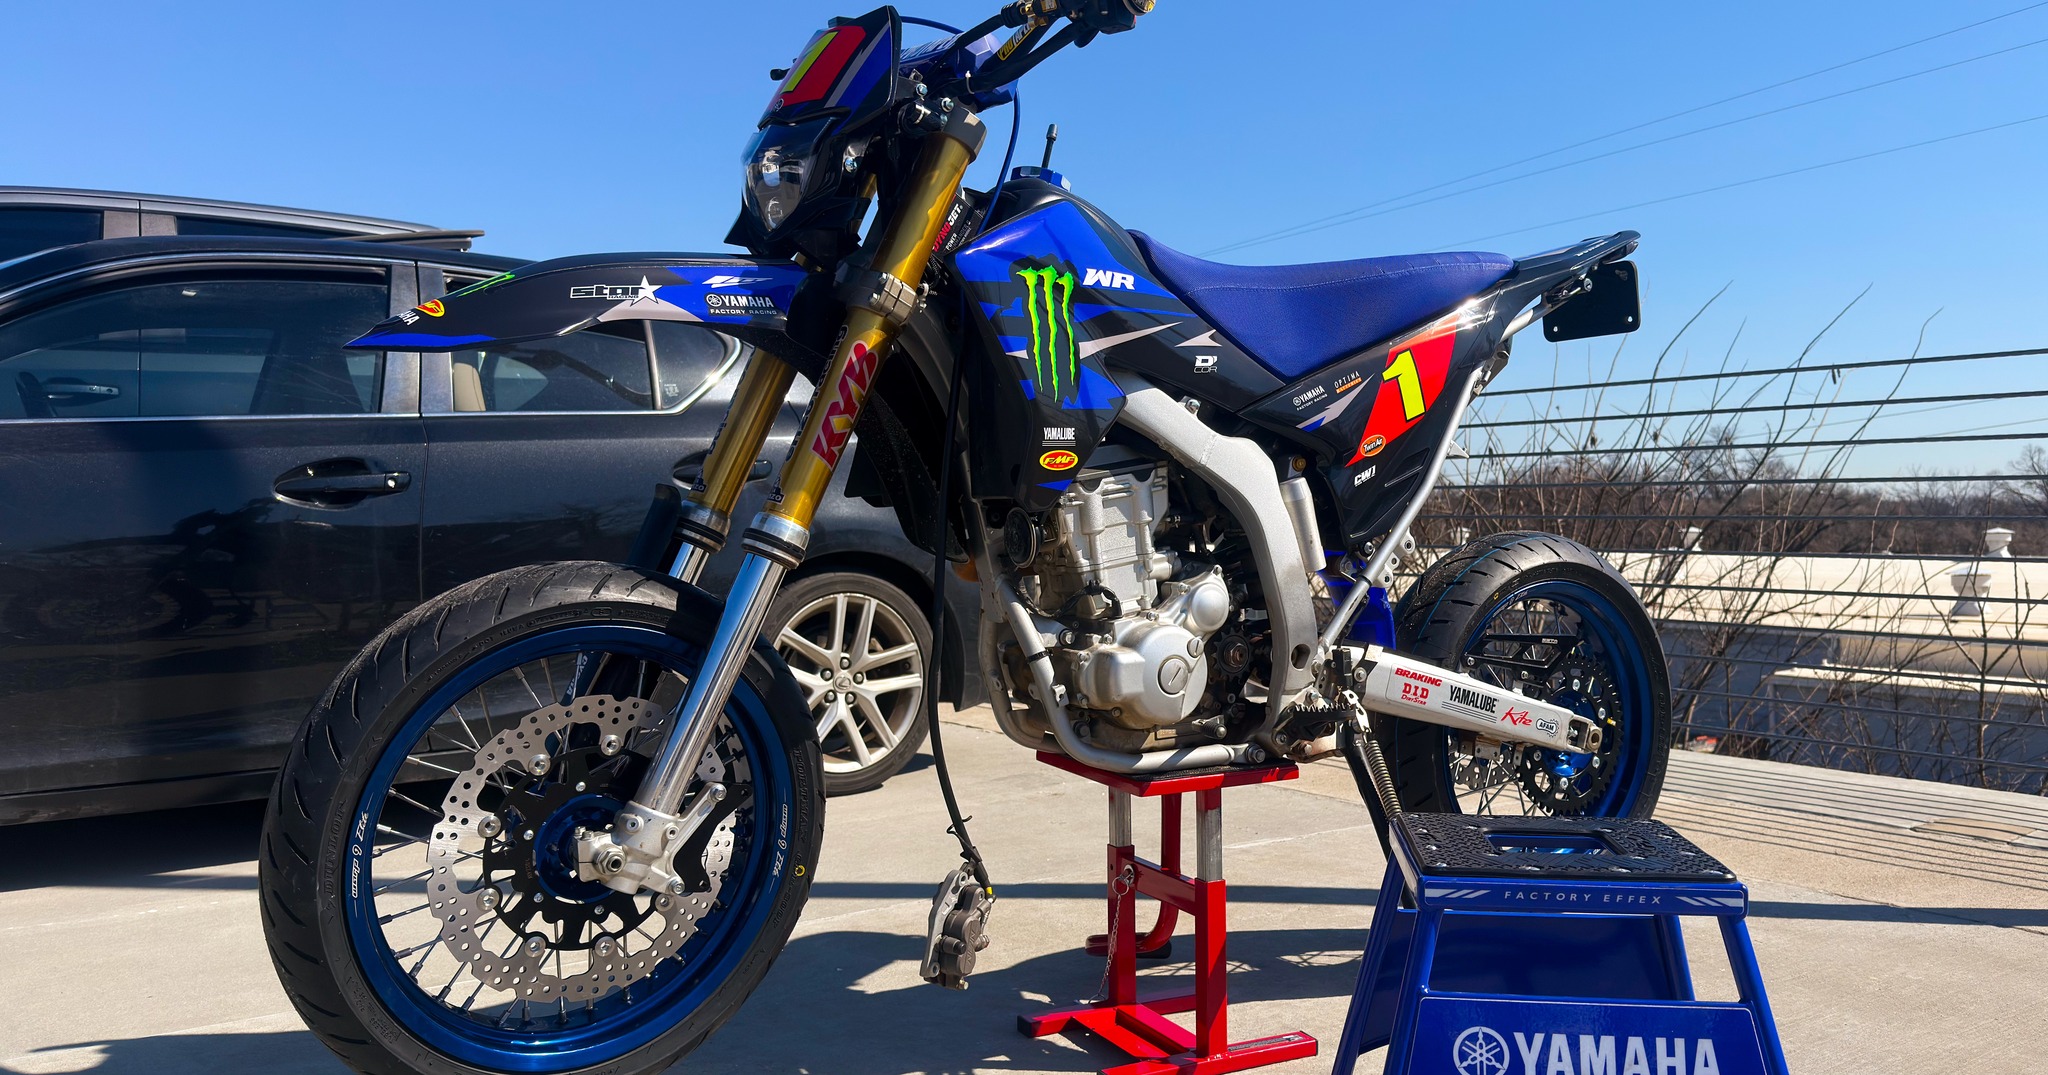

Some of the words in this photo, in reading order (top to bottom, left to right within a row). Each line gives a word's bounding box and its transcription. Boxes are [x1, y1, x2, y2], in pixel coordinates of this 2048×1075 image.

[1083, 268, 1135, 290] WR
[721, 295, 774, 308] YAMAHA
[1334, 371, 1360, 388] OPTIMA
[1382, 348, 1426, 423] 1
[1299, 385, 1326, 403] YAMAHA
[1043, 427, 1076, 440] YAMALUBE
[1043, 455, 1076, 465] FMF
[1395, 668, 1443, 687] BRAKING
[1449, 685, 1497, 713] YAMALUBE
[1539, 721, 1554, 732] AFAM
[1504, 891, 1592, 902] FACTORY
[1603, 893, 1662, 905] EFFEX
[1513, 1031, 1720, 1075] YAMAHA
